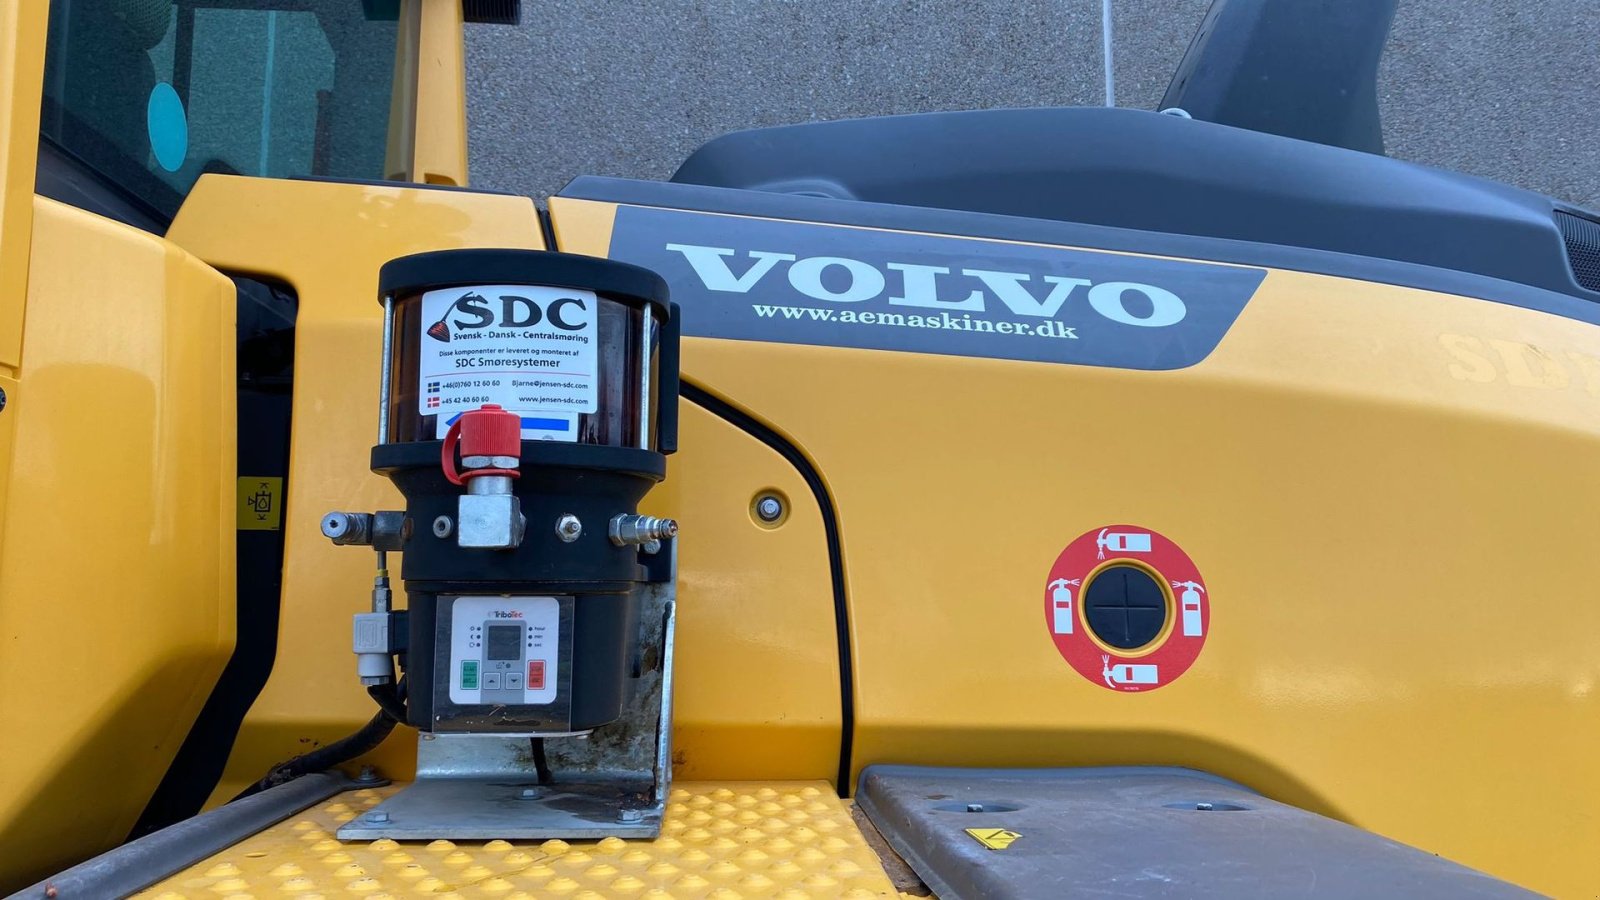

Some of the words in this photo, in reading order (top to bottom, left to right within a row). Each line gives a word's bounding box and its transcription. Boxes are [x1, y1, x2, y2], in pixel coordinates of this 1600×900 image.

[666, 243, 1187, 327] VOLVO
[453, 294, 587, 331] SDC
[752, 304, 1079, 340] www.aemaskiner.dk
[453, 332, 482, 341] Svensk
[488, 331, 516, 339] Dansk
[523, 331, 589, 344] Centralsmøring
[454, 349, 496, 357] komponenter
[455, 358, 476, 368] SDC
[478, 357, 560, 368] Smøresystemer
[442, 381, 472, 389] +46(0)760
[512, 380, 589, 390] Bjarne@jensen-sdc.com
[519, 396, 589, 405] www.jensen-sdc.com
